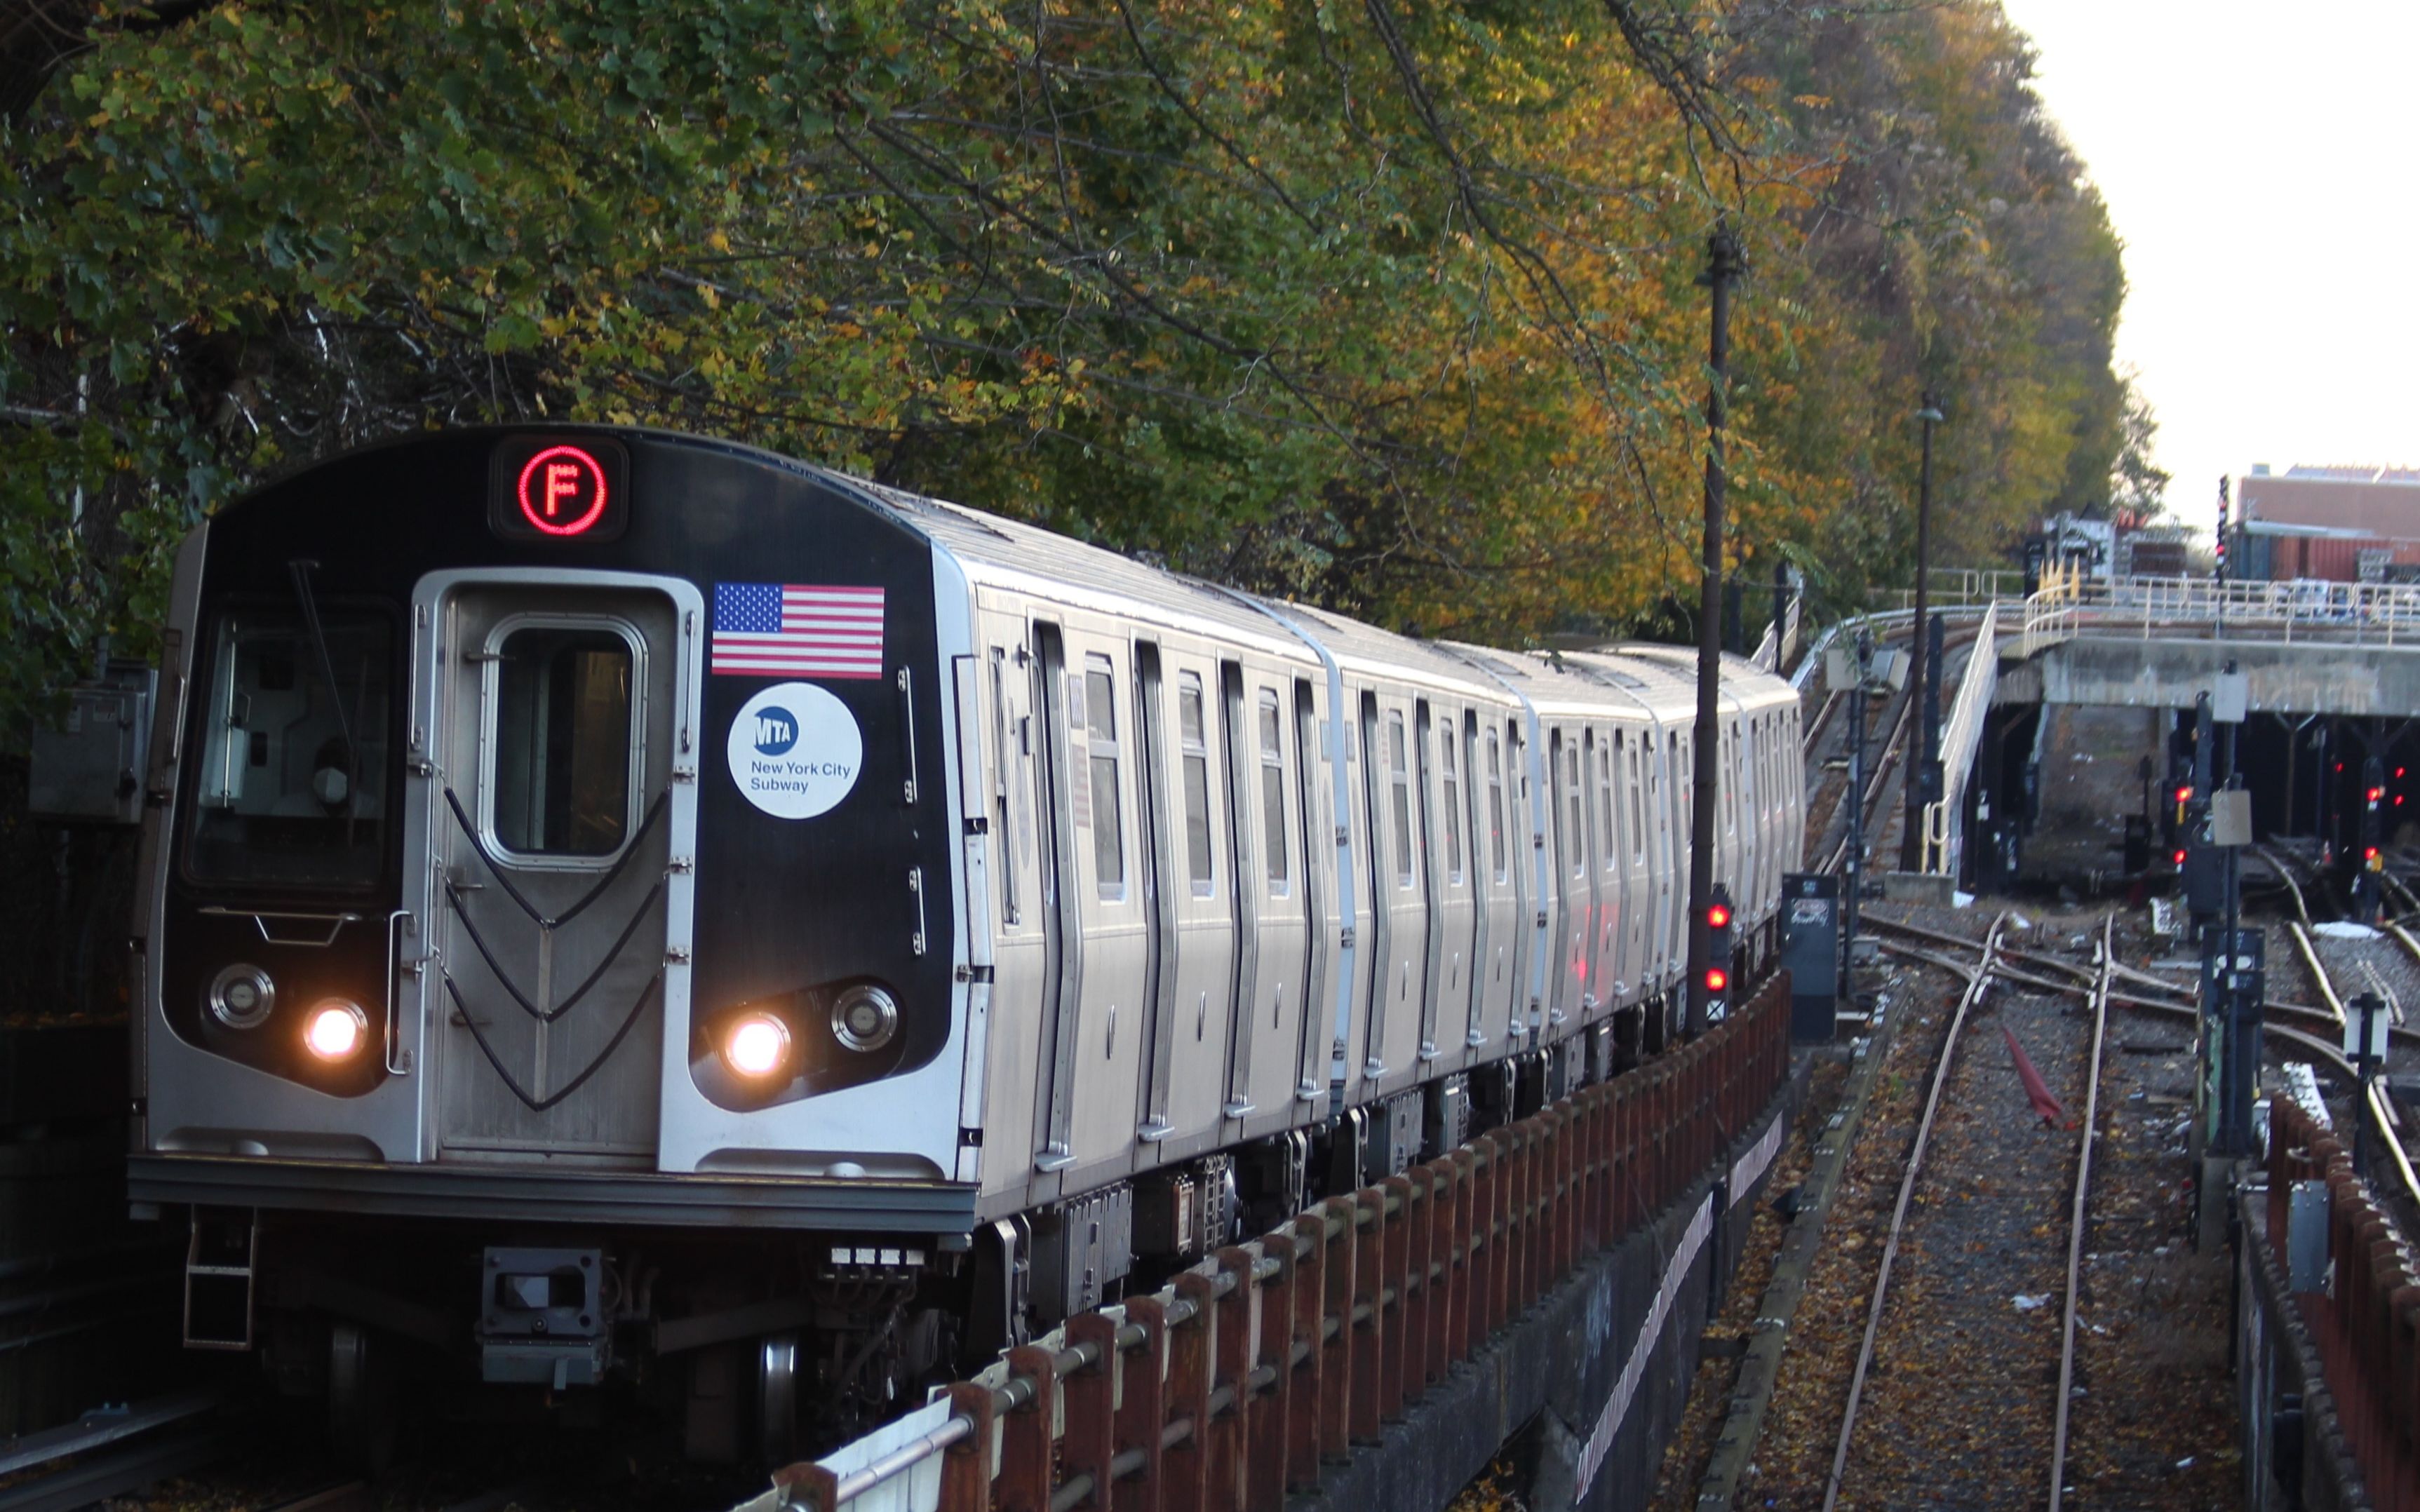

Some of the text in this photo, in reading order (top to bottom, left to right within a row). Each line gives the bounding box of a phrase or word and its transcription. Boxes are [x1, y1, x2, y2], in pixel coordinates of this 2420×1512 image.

[546, 464, 579, 518] F
[753, 716, 791, 746] MTA
[751, 760, 851, 779] New York City
[751, 778, 809, 795] Subway
